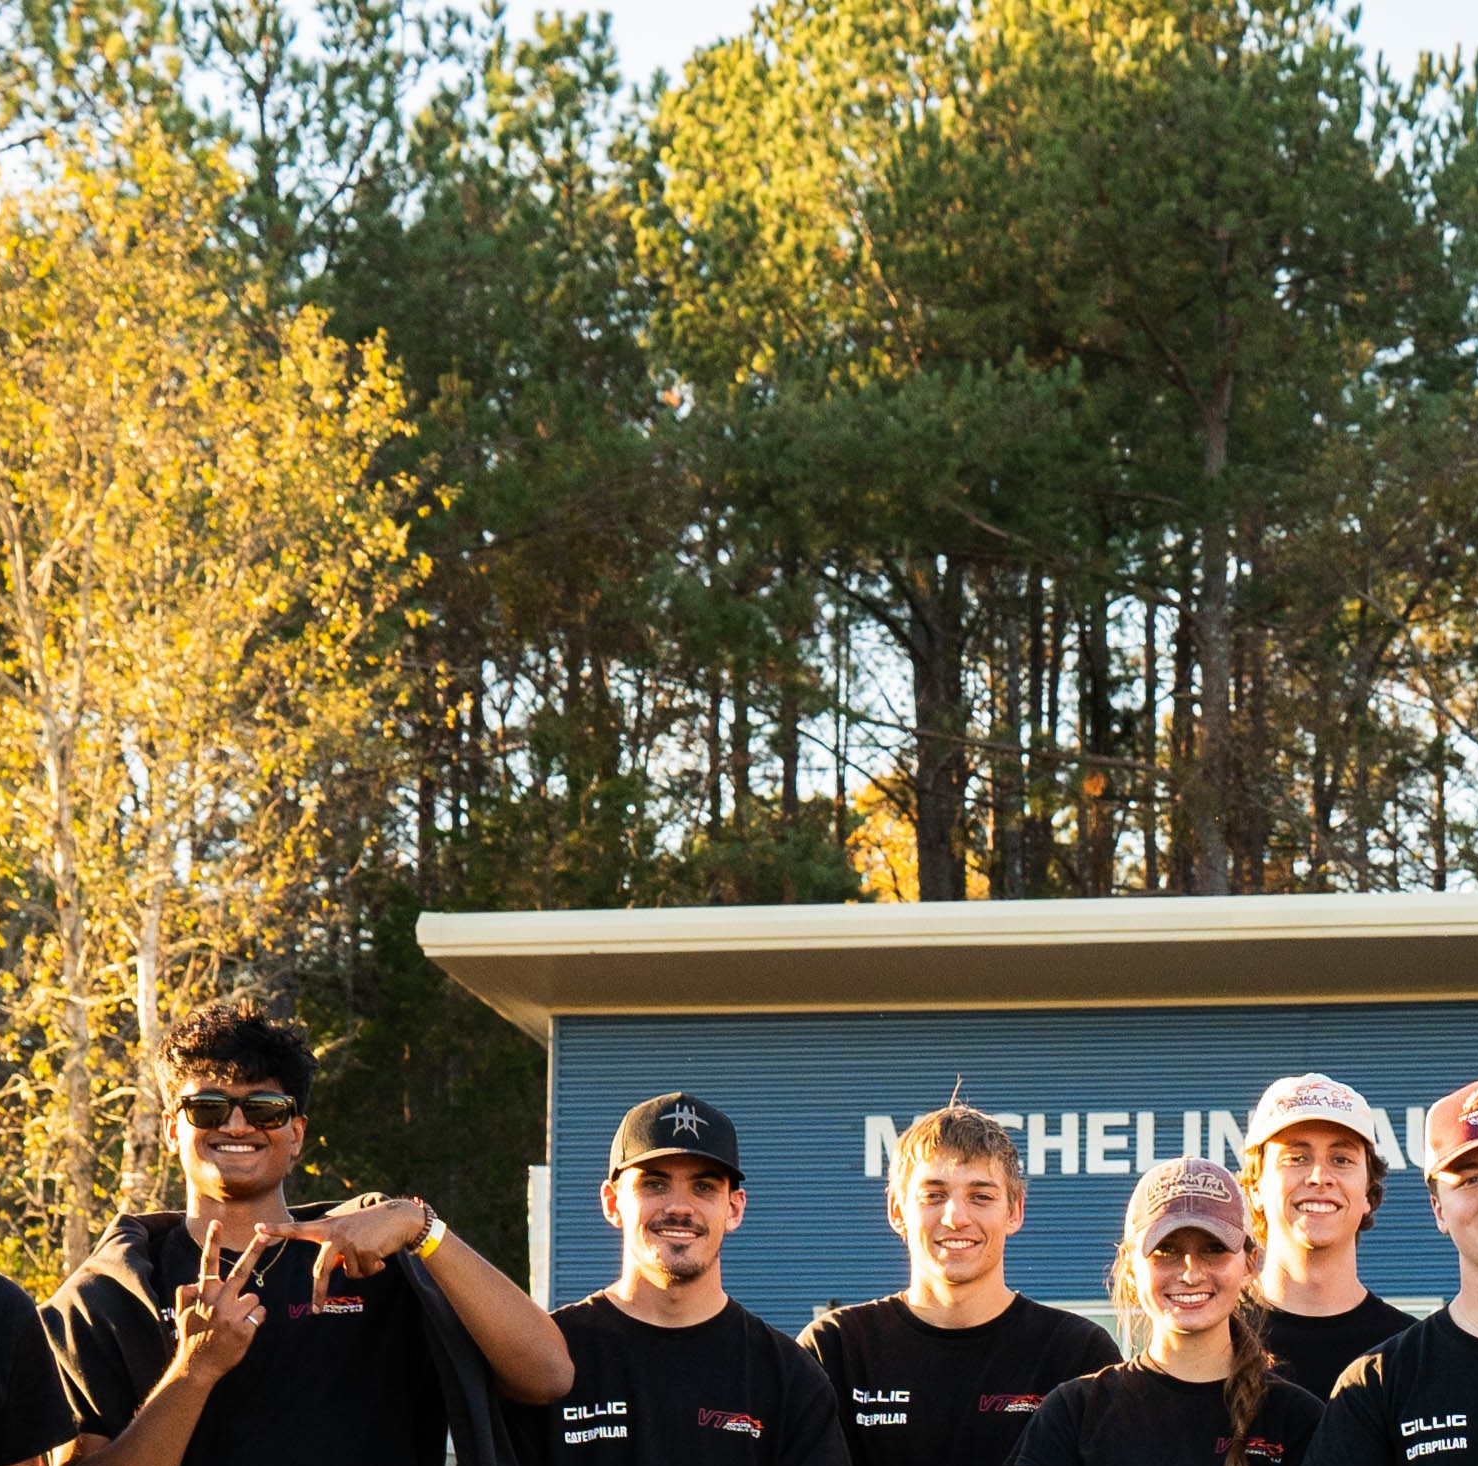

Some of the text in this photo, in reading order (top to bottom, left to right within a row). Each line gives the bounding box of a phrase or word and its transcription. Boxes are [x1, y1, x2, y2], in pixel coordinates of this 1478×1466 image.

[562, 1401, 628, 1421] GILLIG
[564, 1425, 628, 1444] CATERPILLAR
[1400, 1414, 1468, 1437] GILLIG
[1406, 1437, 1468, 1461] CATERPILLAR
